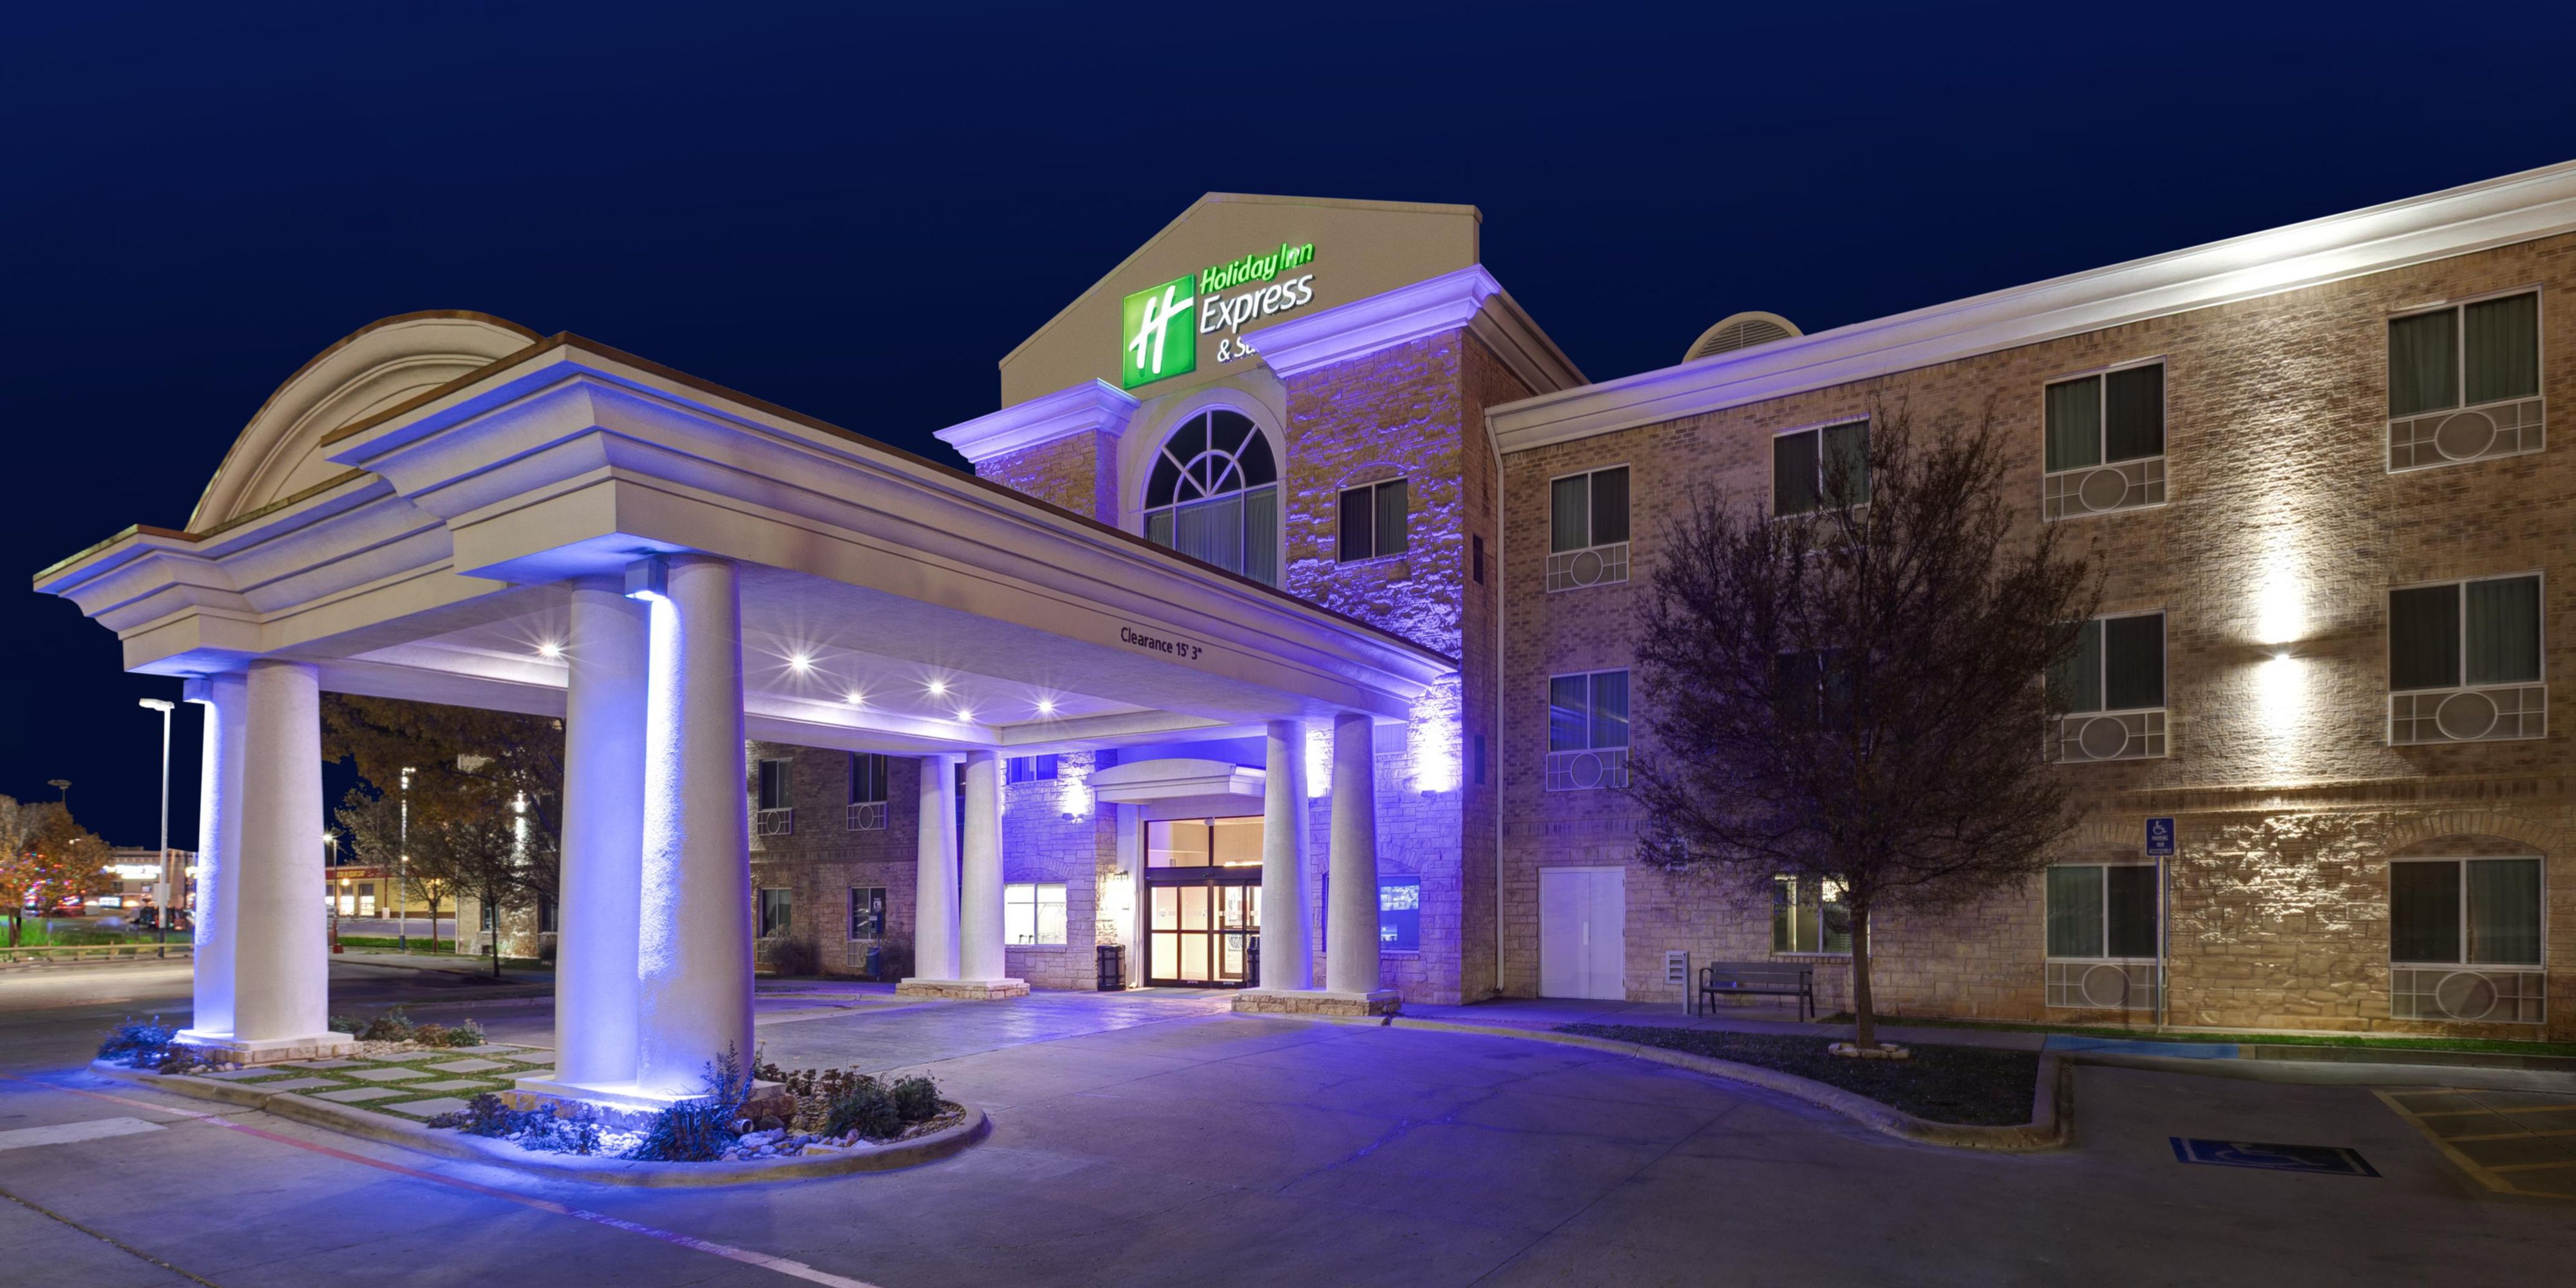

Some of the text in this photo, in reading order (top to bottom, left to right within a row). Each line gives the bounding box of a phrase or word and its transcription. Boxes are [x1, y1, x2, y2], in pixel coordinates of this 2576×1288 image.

[1200, 242, 1315, 295] Holiday Inn
[1200, 274, 1314, 334] Express
[1217, 339, 1231, 362] &
[1121, 627, 1202, 660] Clearance 15' 3"
